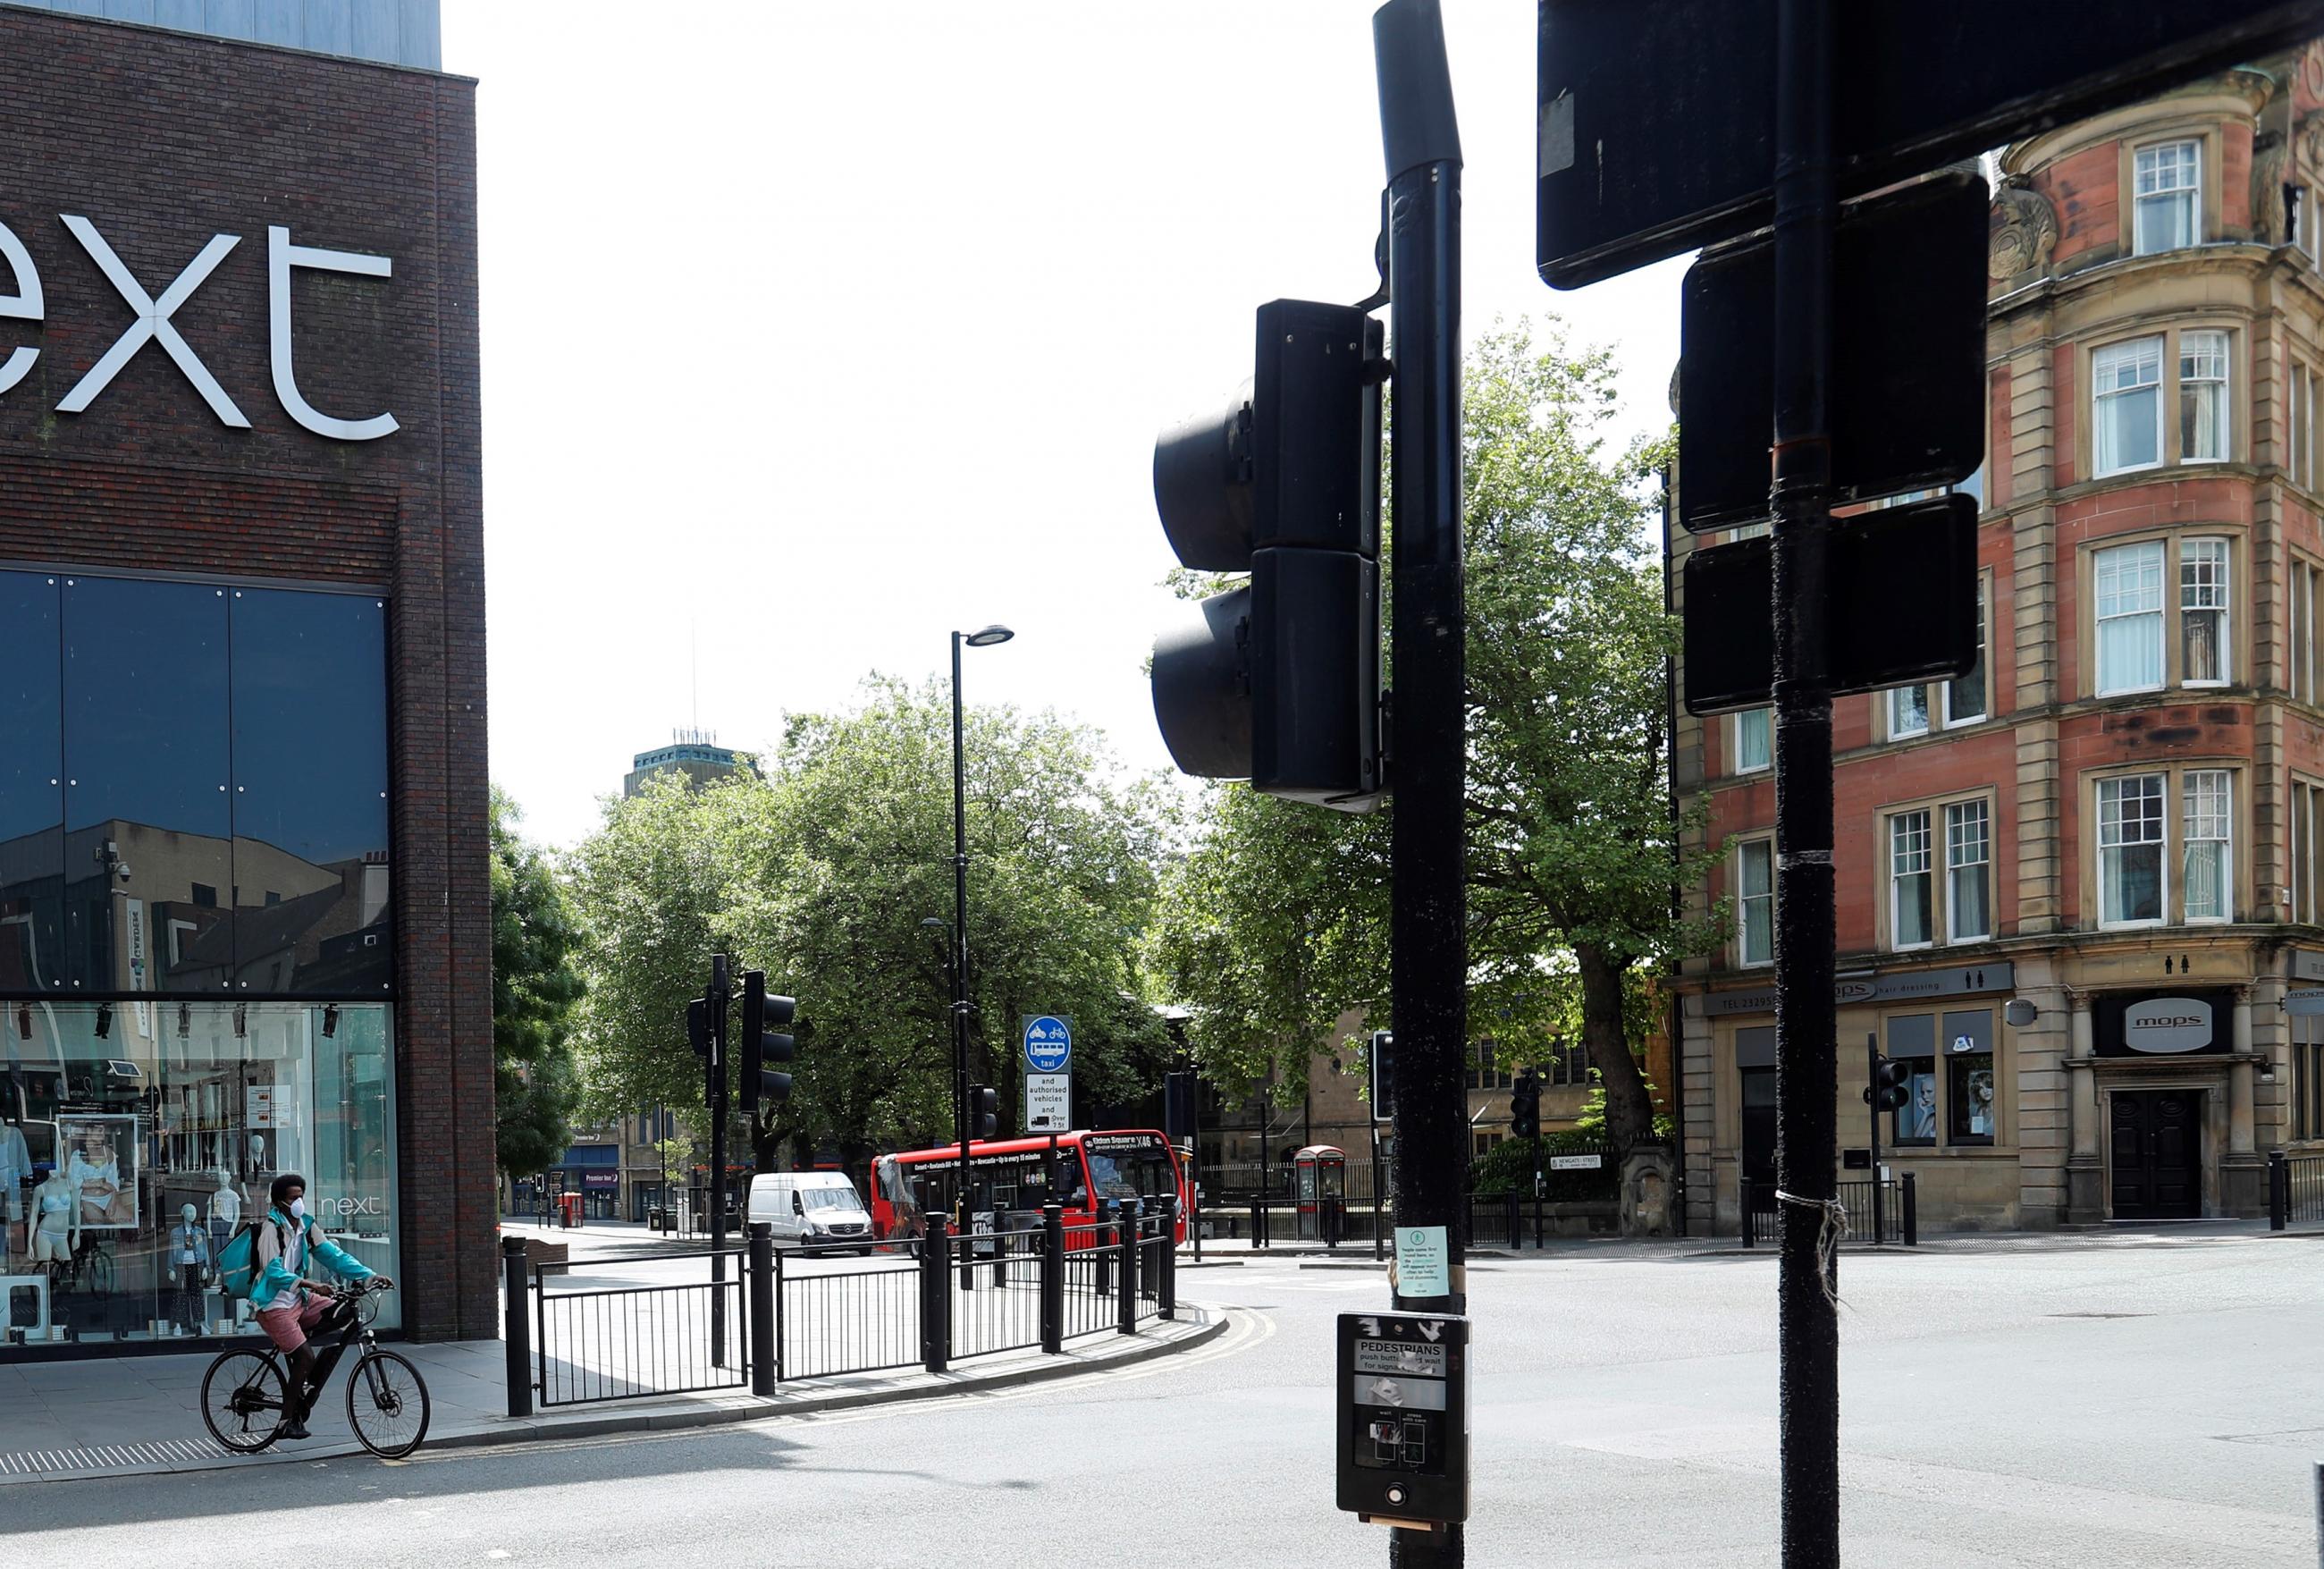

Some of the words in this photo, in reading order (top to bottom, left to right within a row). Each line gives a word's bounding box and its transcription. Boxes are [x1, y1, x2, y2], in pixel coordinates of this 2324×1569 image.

[0, 213, 400, 441] xt
[1834, 983, 1867, 998] ps
[1900, 983, 1940, 992] dressing
[1722, 1000, 1739, 1009] TEL
[2136, 1016, 2202, 1028] mops
[1111, 1136, 1135, 1144] Square
[1136, 1135, 1151, 1148] X46
[321, 1195, 381, 1215] next
[1360, 1342, 1441, 1356] PEDESTRIANS
